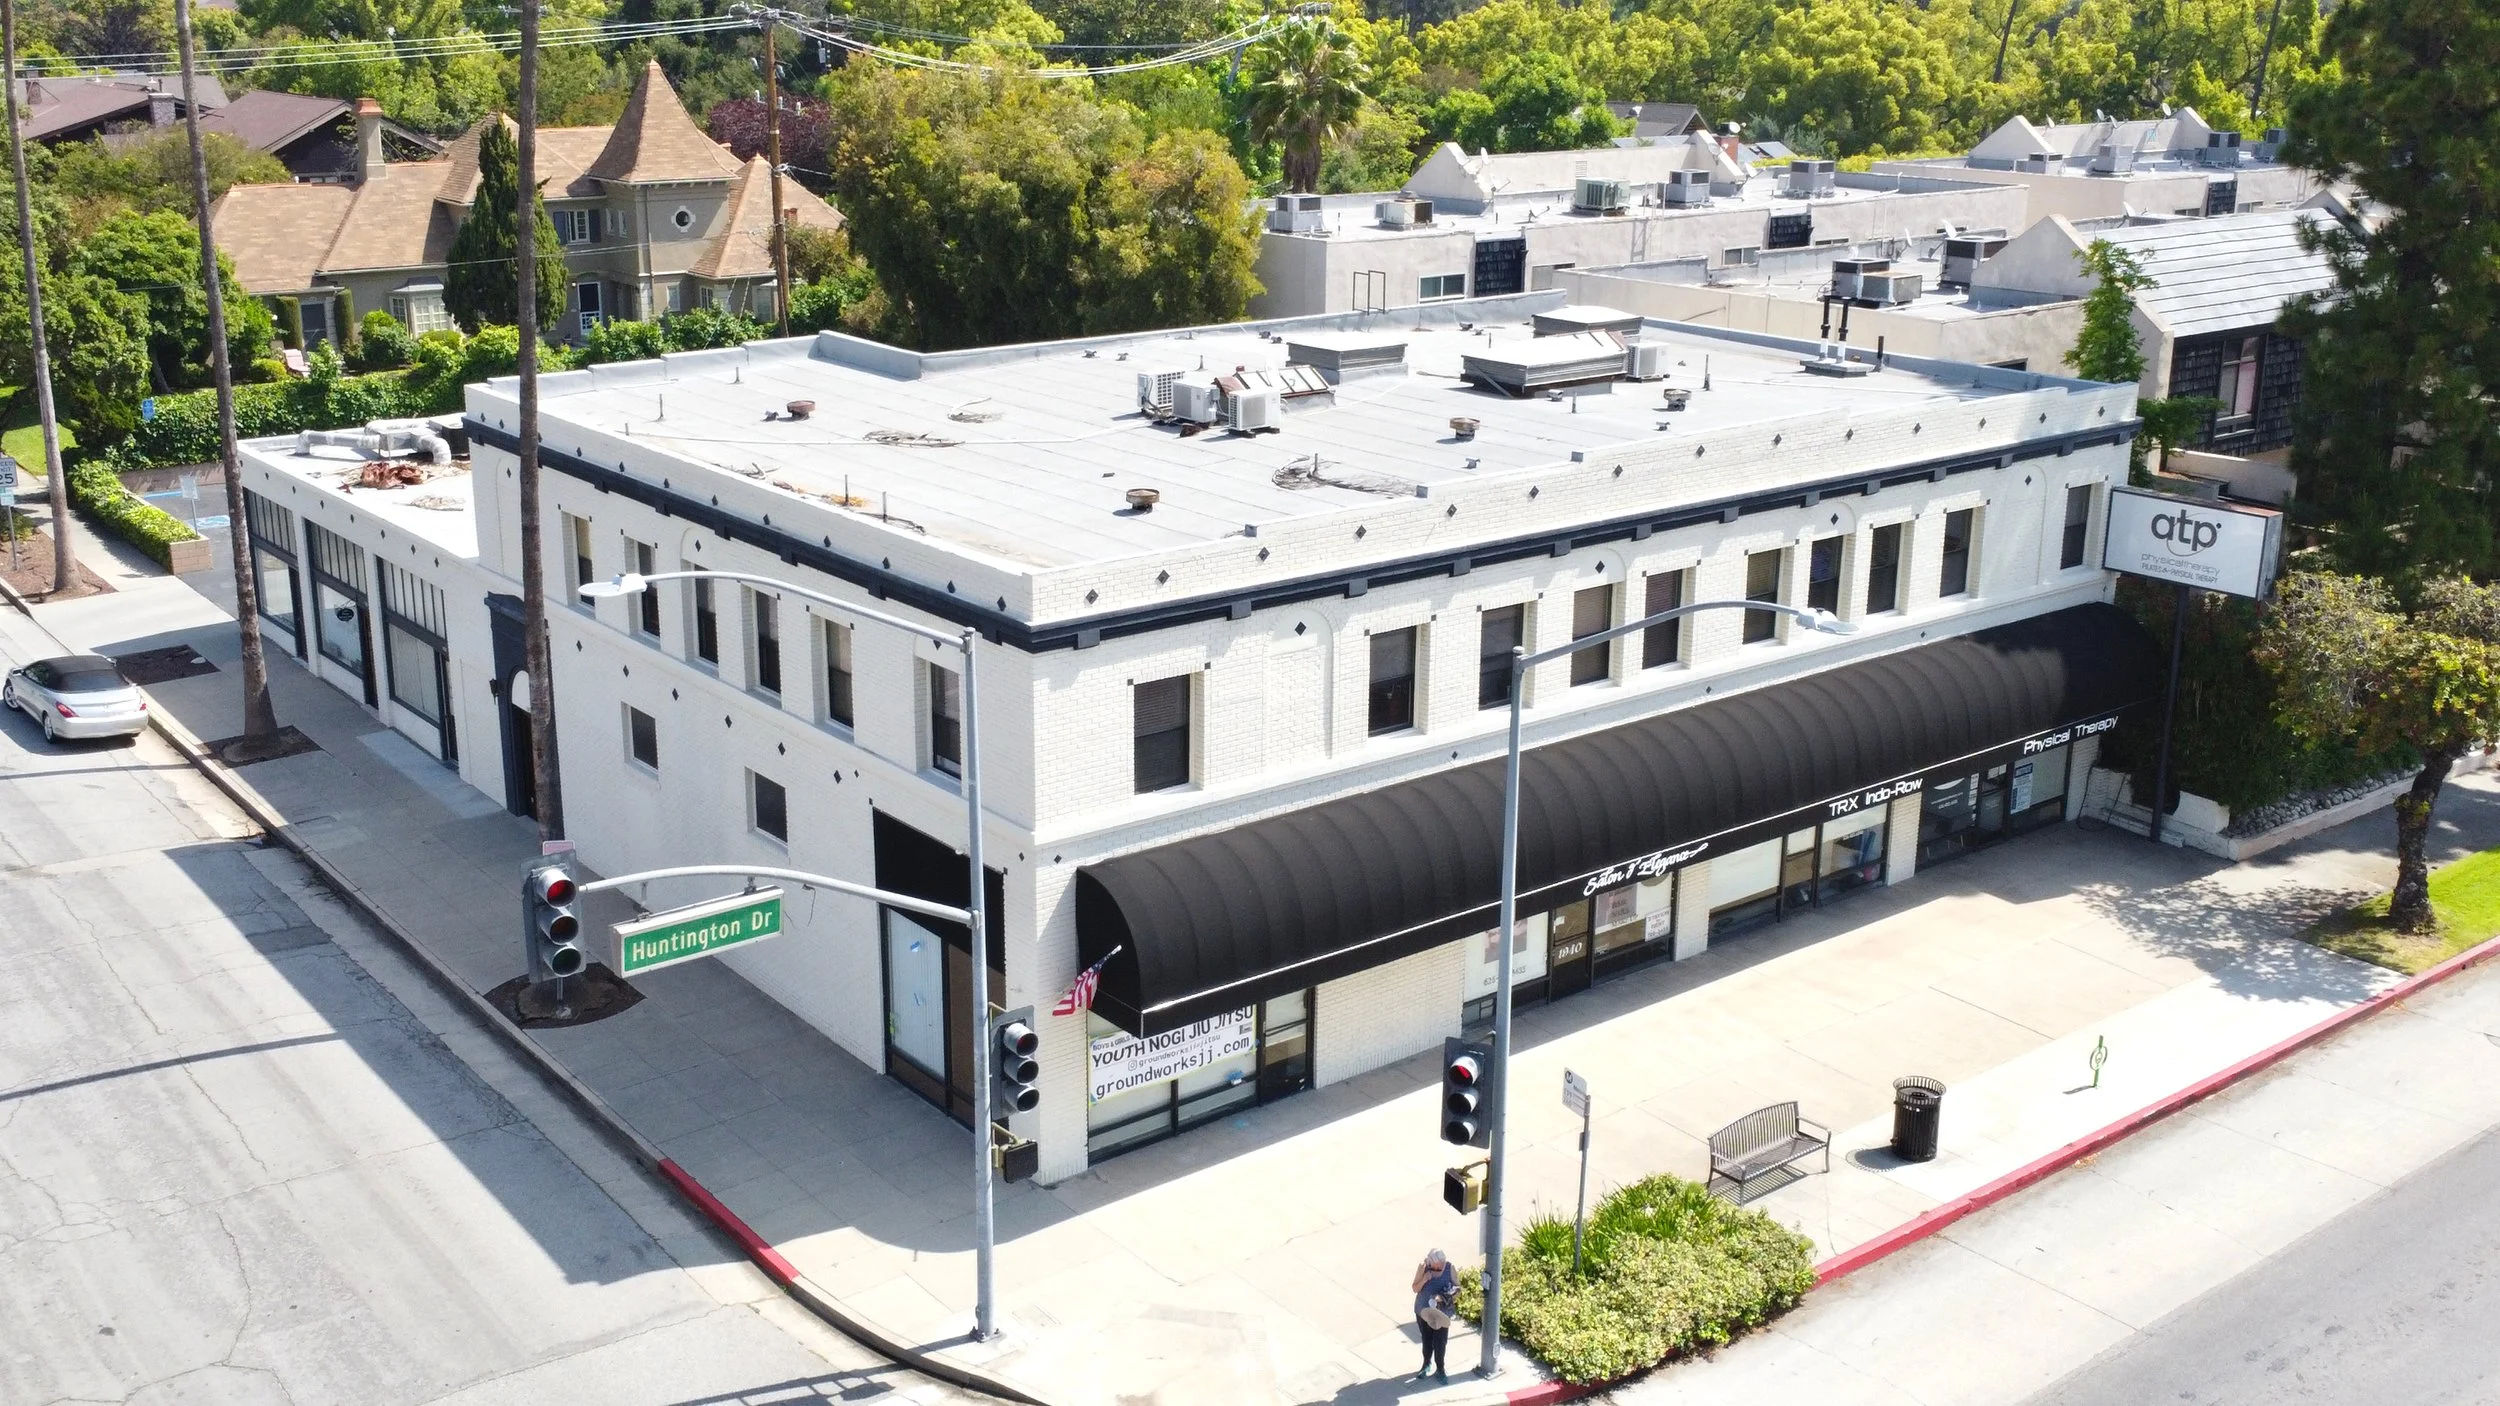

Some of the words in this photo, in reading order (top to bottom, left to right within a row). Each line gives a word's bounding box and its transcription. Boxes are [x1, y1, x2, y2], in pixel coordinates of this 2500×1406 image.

[2151, 509, 2218, 551] atp
[2023, 728, 2070, 754] Physical
[2075, 715, 2118, 738] Therapy
[1829, 795, 1859, 817] TRX
[1865, 778, 1923, 805] Indo-Row
[1583, 866, 1625, 896] Salon
[632, 919, 741, 962] Huntington
[752, 910, 773, 931] Dr
[1092, 1040, 1146, 1067] YOUTH
[1149, 1028, 1185, 1053] NOGI
[1189, 1018, 1211, 1039] JIU
[1214, 1005, 1253, 1030] JITSU
[1096, 1037, 1250, 1099] groundworksjj.com
